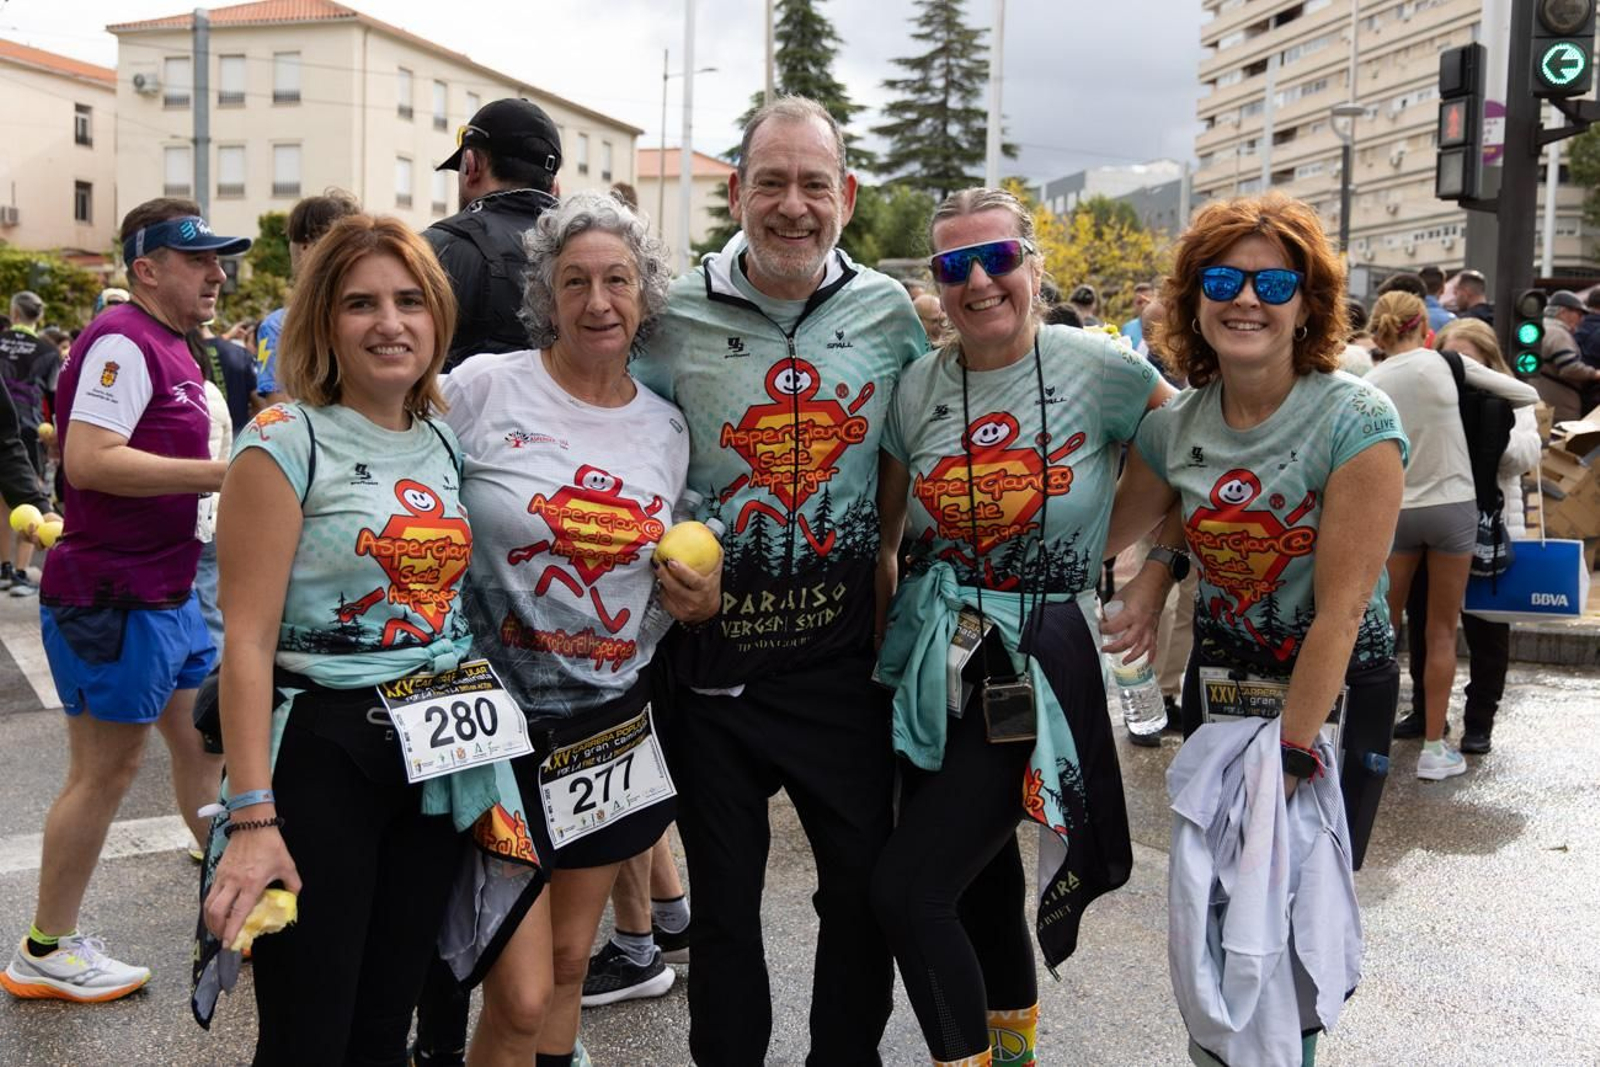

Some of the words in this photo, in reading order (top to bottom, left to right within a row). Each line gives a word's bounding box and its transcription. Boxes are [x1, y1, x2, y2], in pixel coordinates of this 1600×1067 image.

[1531, 592, 1569, 607] BBVA
[1209, 685, 1237, 704] XXV
[1250, 697, 1276, 706] gran
[424, 697, 498, 749] 280
[583, 742, 609, 758] gran
[568, 752, 635, 816] 277
